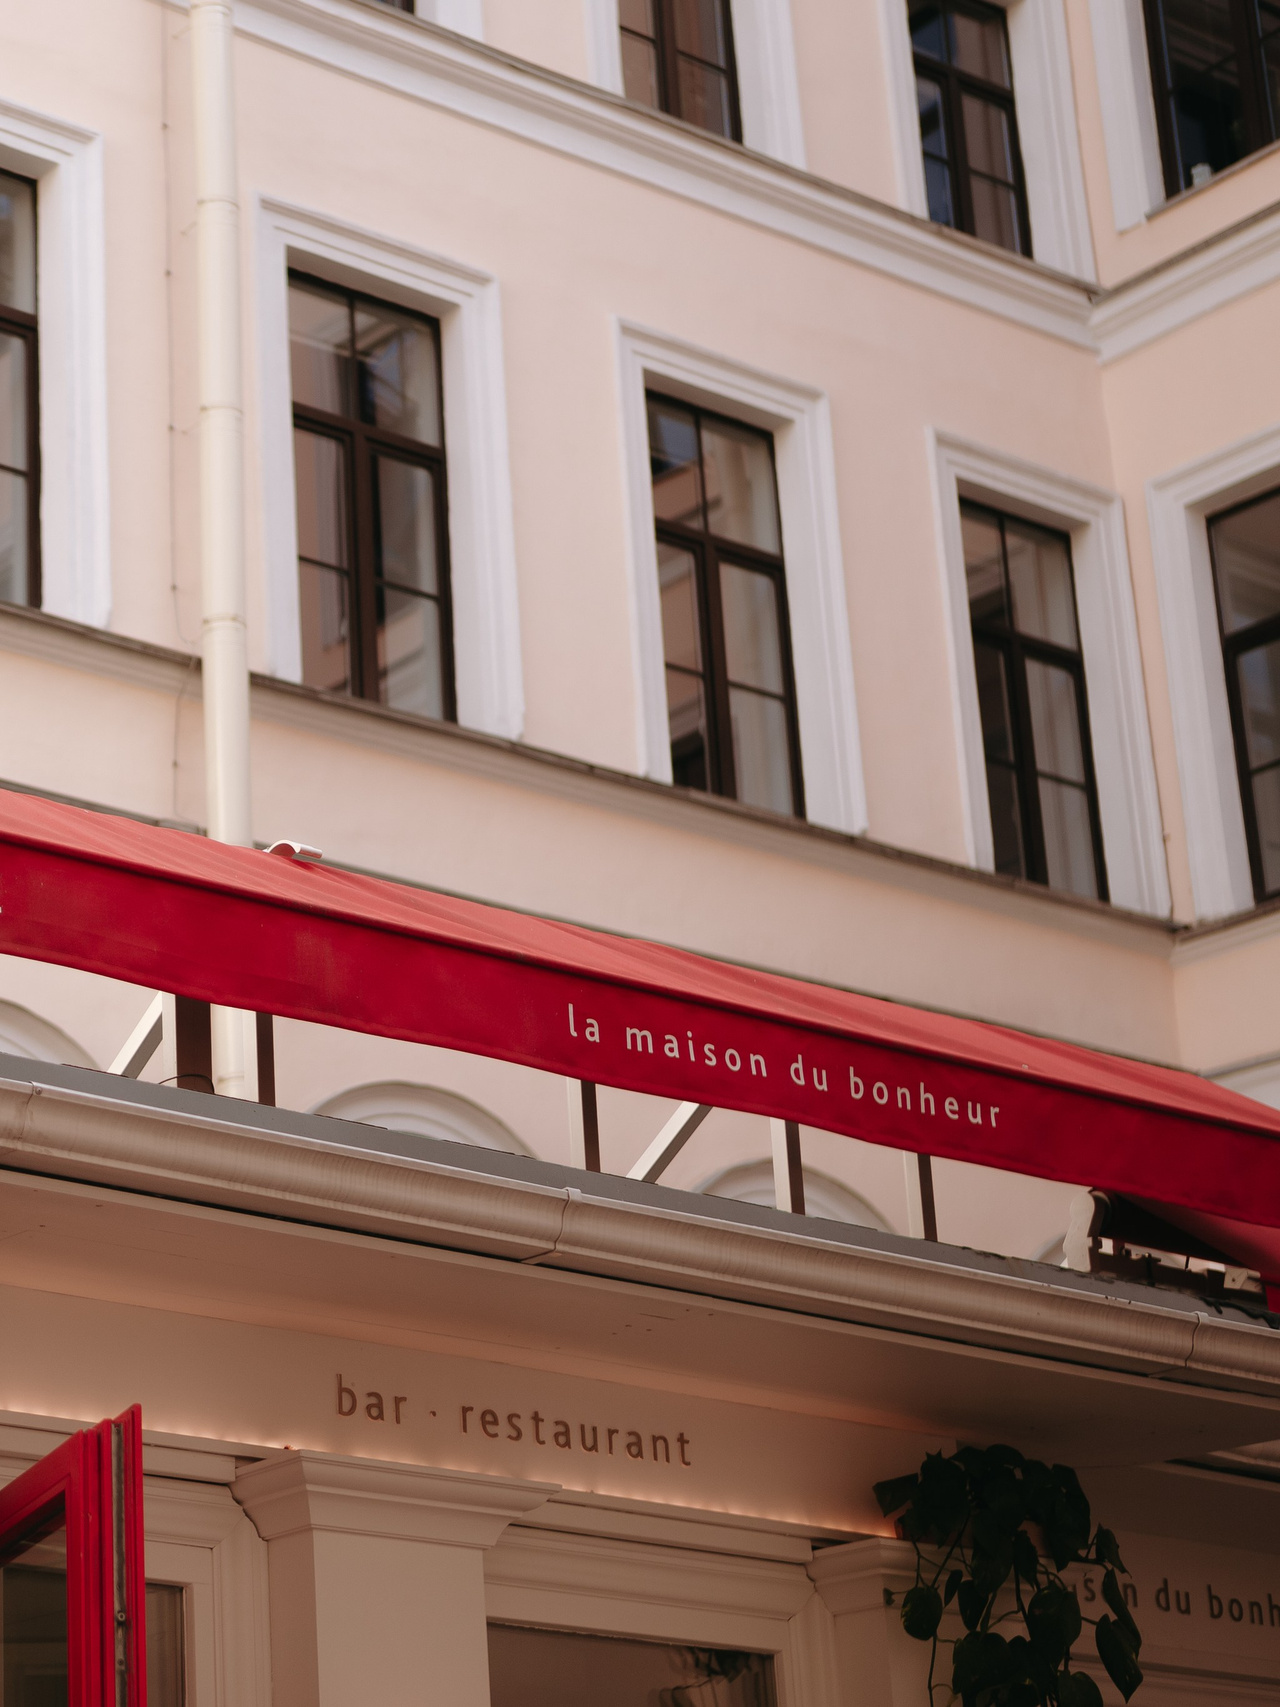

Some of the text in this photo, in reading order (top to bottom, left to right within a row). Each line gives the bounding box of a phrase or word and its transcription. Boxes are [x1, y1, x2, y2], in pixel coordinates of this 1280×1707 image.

[567, 1003, 1001, 1128] la maison du bonheur
[335, 1373, 408, 1426] bar
[460, 1404, 693, 1468] restaurant
[1154, 1577, 1192, 1616] du
[1206, 1583, 1280, 1627] bonh
